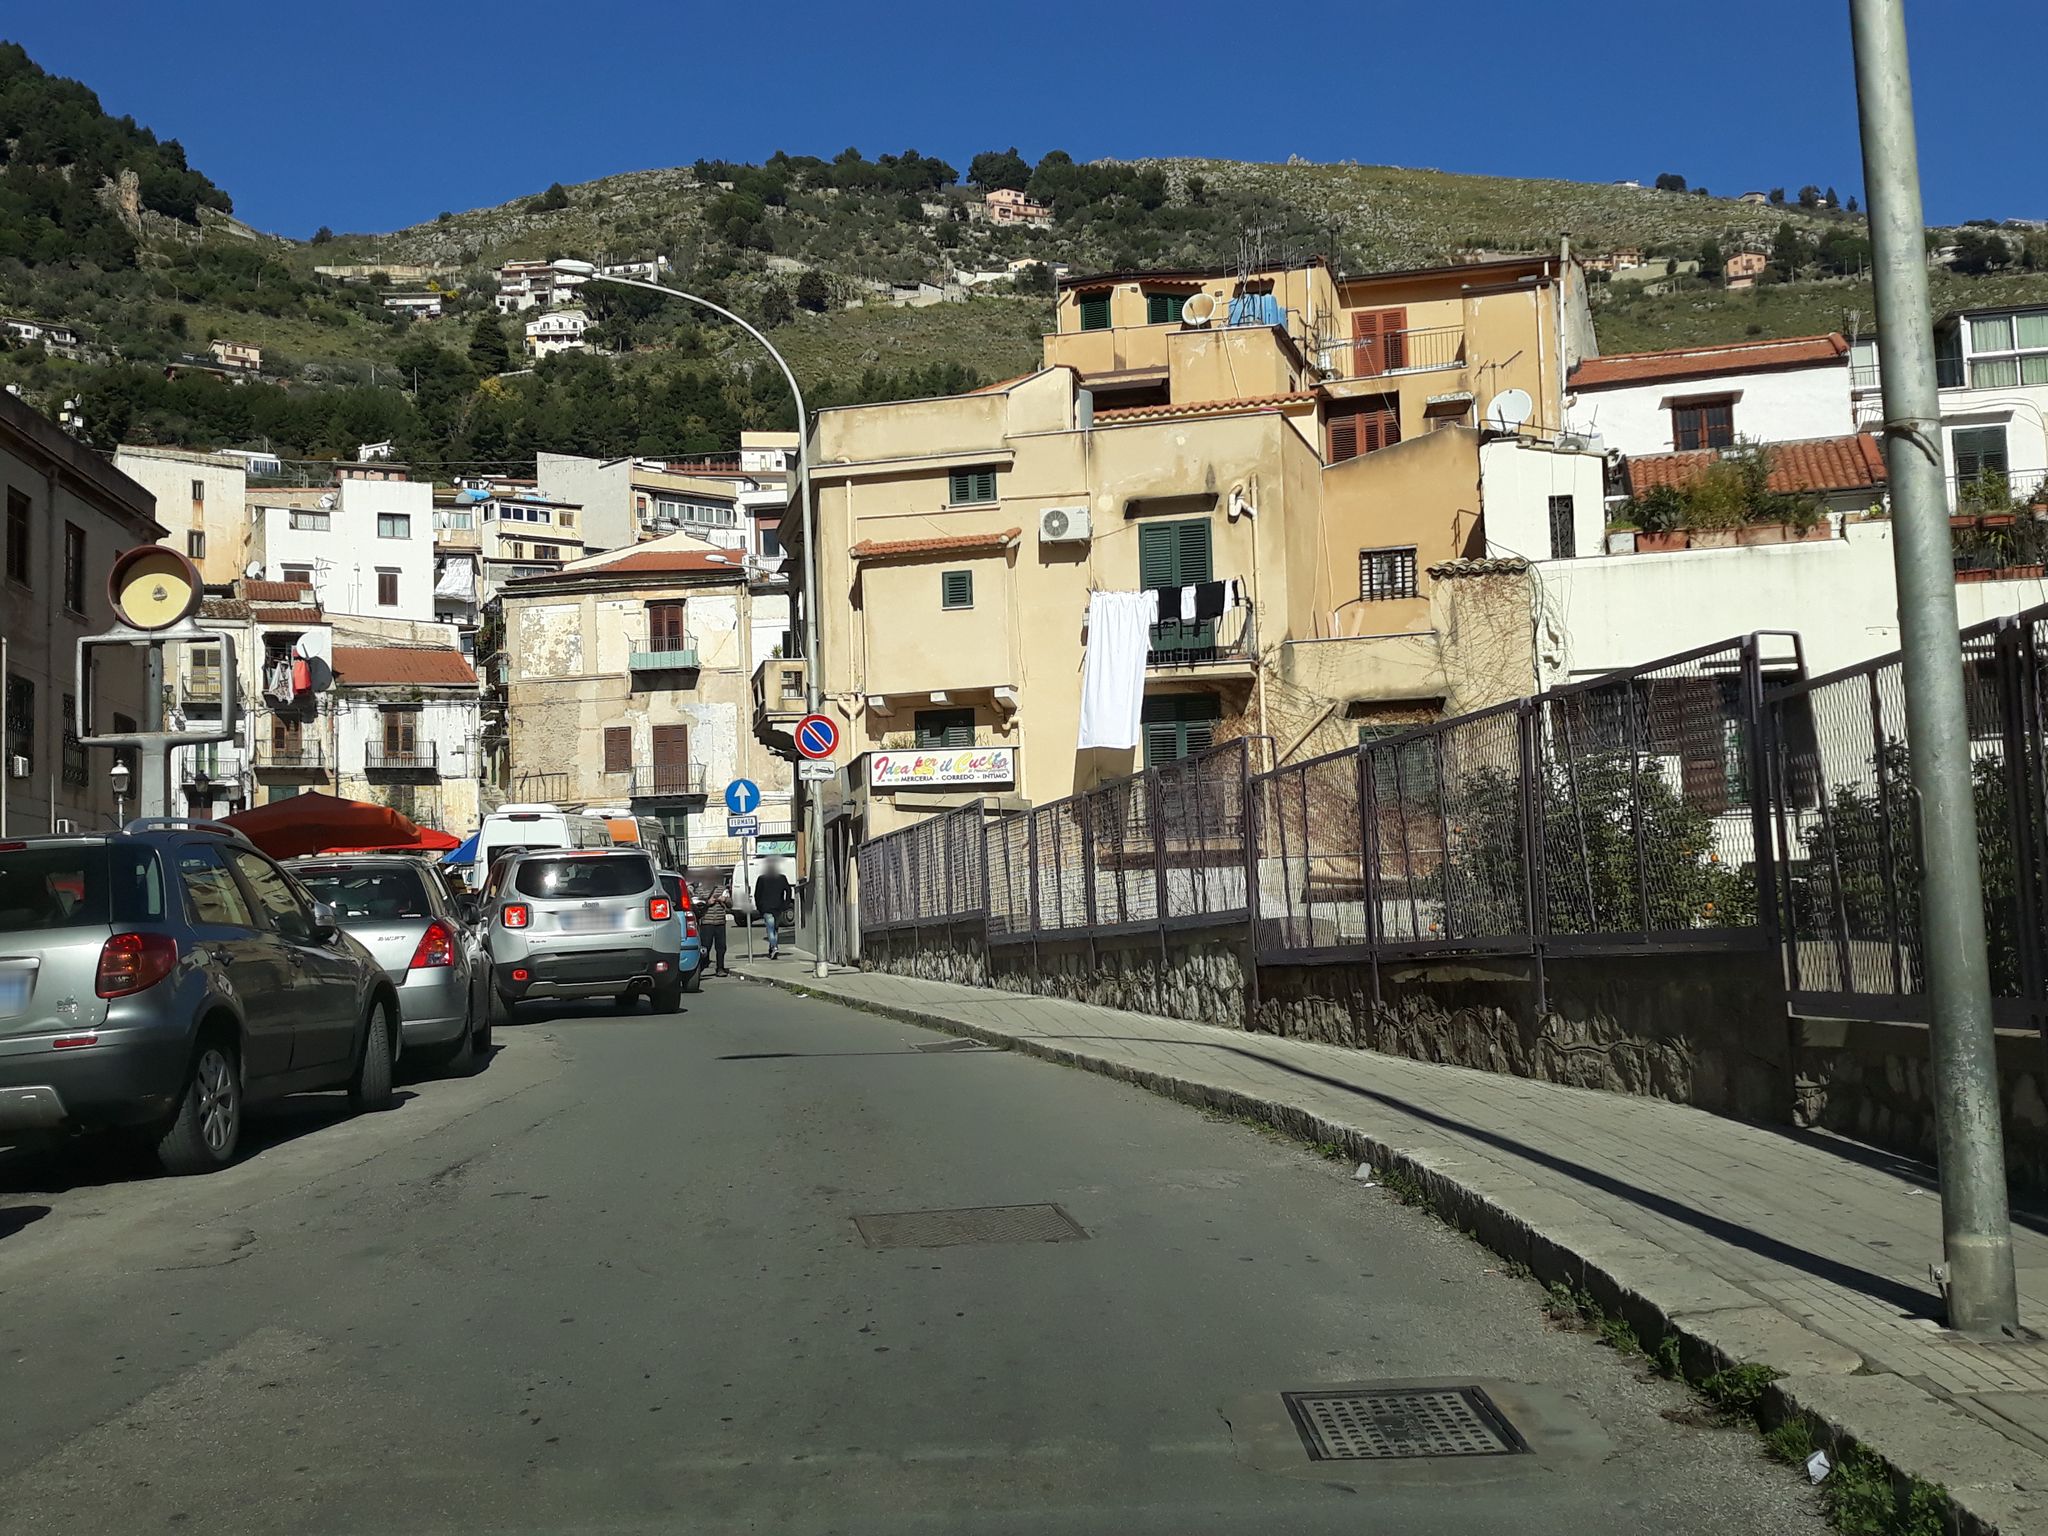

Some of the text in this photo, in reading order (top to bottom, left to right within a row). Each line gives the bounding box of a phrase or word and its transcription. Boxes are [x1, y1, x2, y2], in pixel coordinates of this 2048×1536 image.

[874, 756, 911, 781] Idea
[940, 757, 953, 773] il
[953, 751, 1009, 773] Cucito
[941, 773, 975, 781] CORREDO
[731, 818, 754, 826] FERMATA
